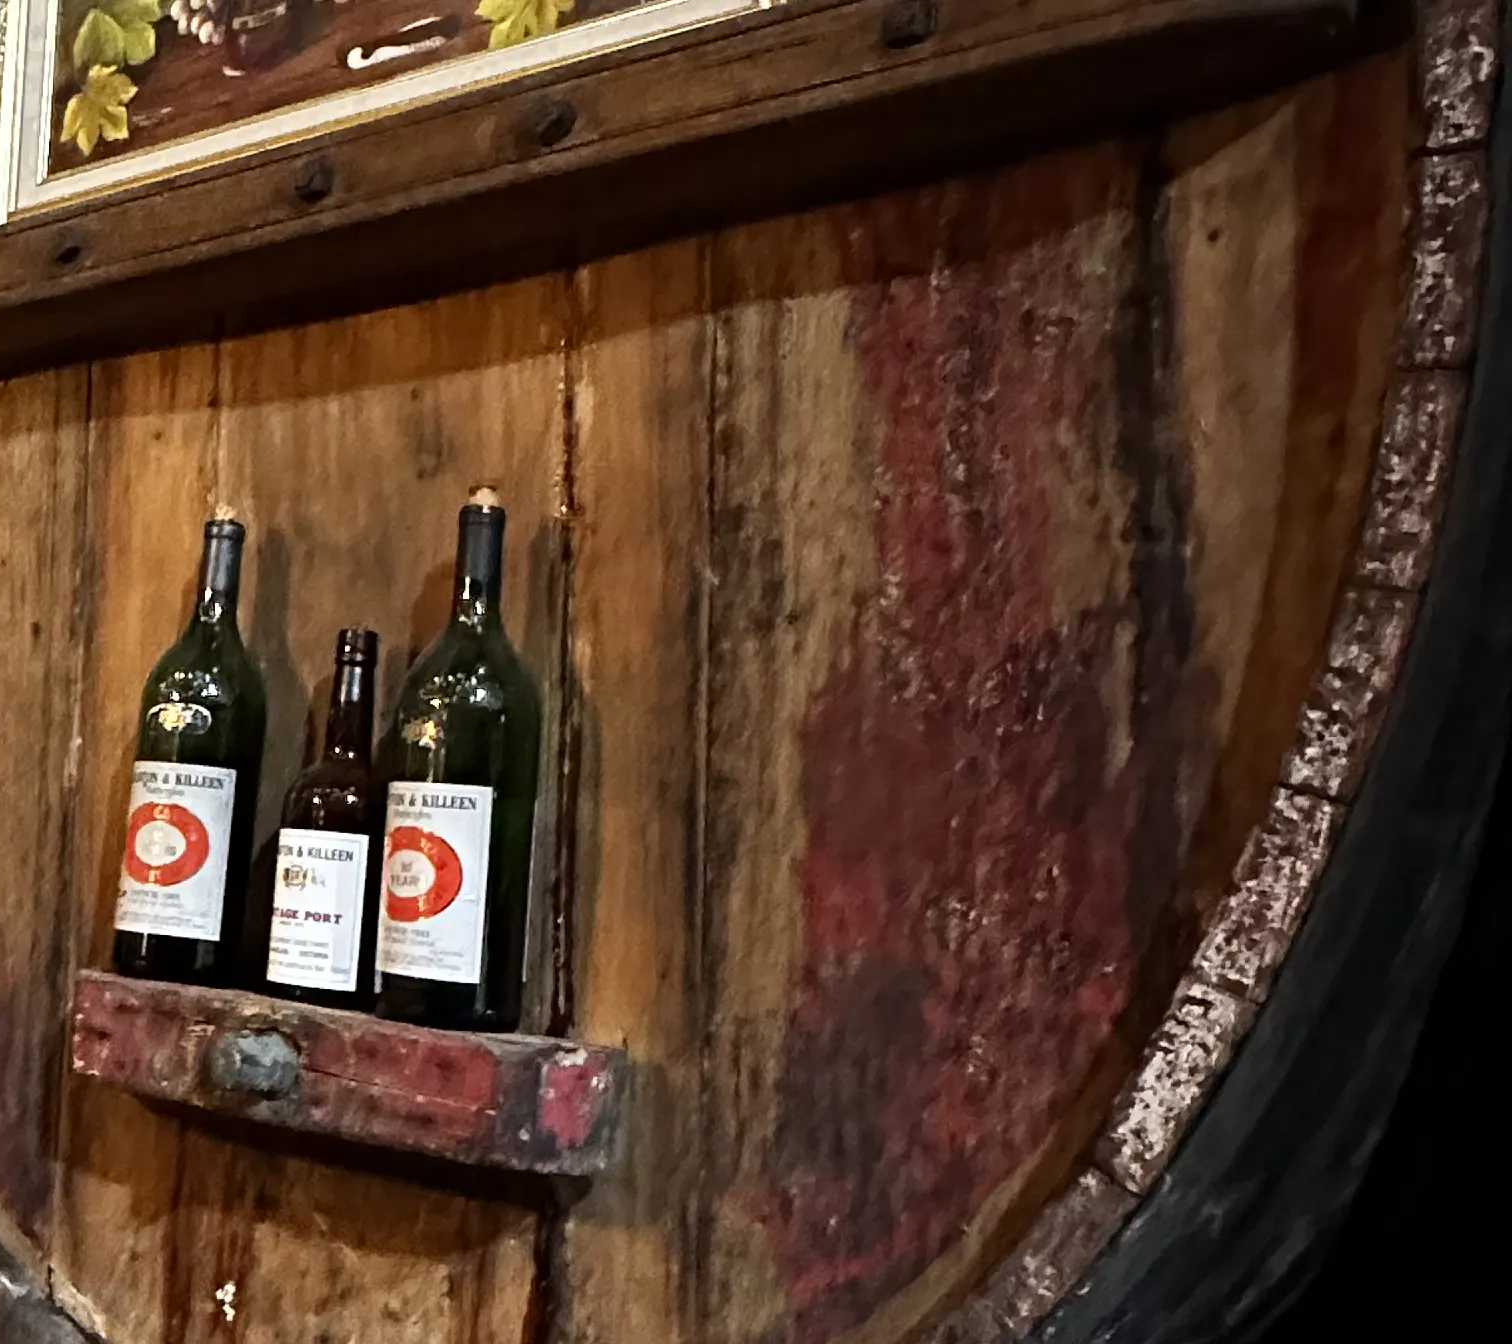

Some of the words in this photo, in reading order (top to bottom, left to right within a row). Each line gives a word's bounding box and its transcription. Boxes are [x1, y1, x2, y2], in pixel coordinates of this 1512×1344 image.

[175, 773, 225, 790] KILLEEN
[421, 793, 478, 811] KILLEEN
[307, 847, 354, 862] KILLEEN
[304, 911, 343, 925] PORT
